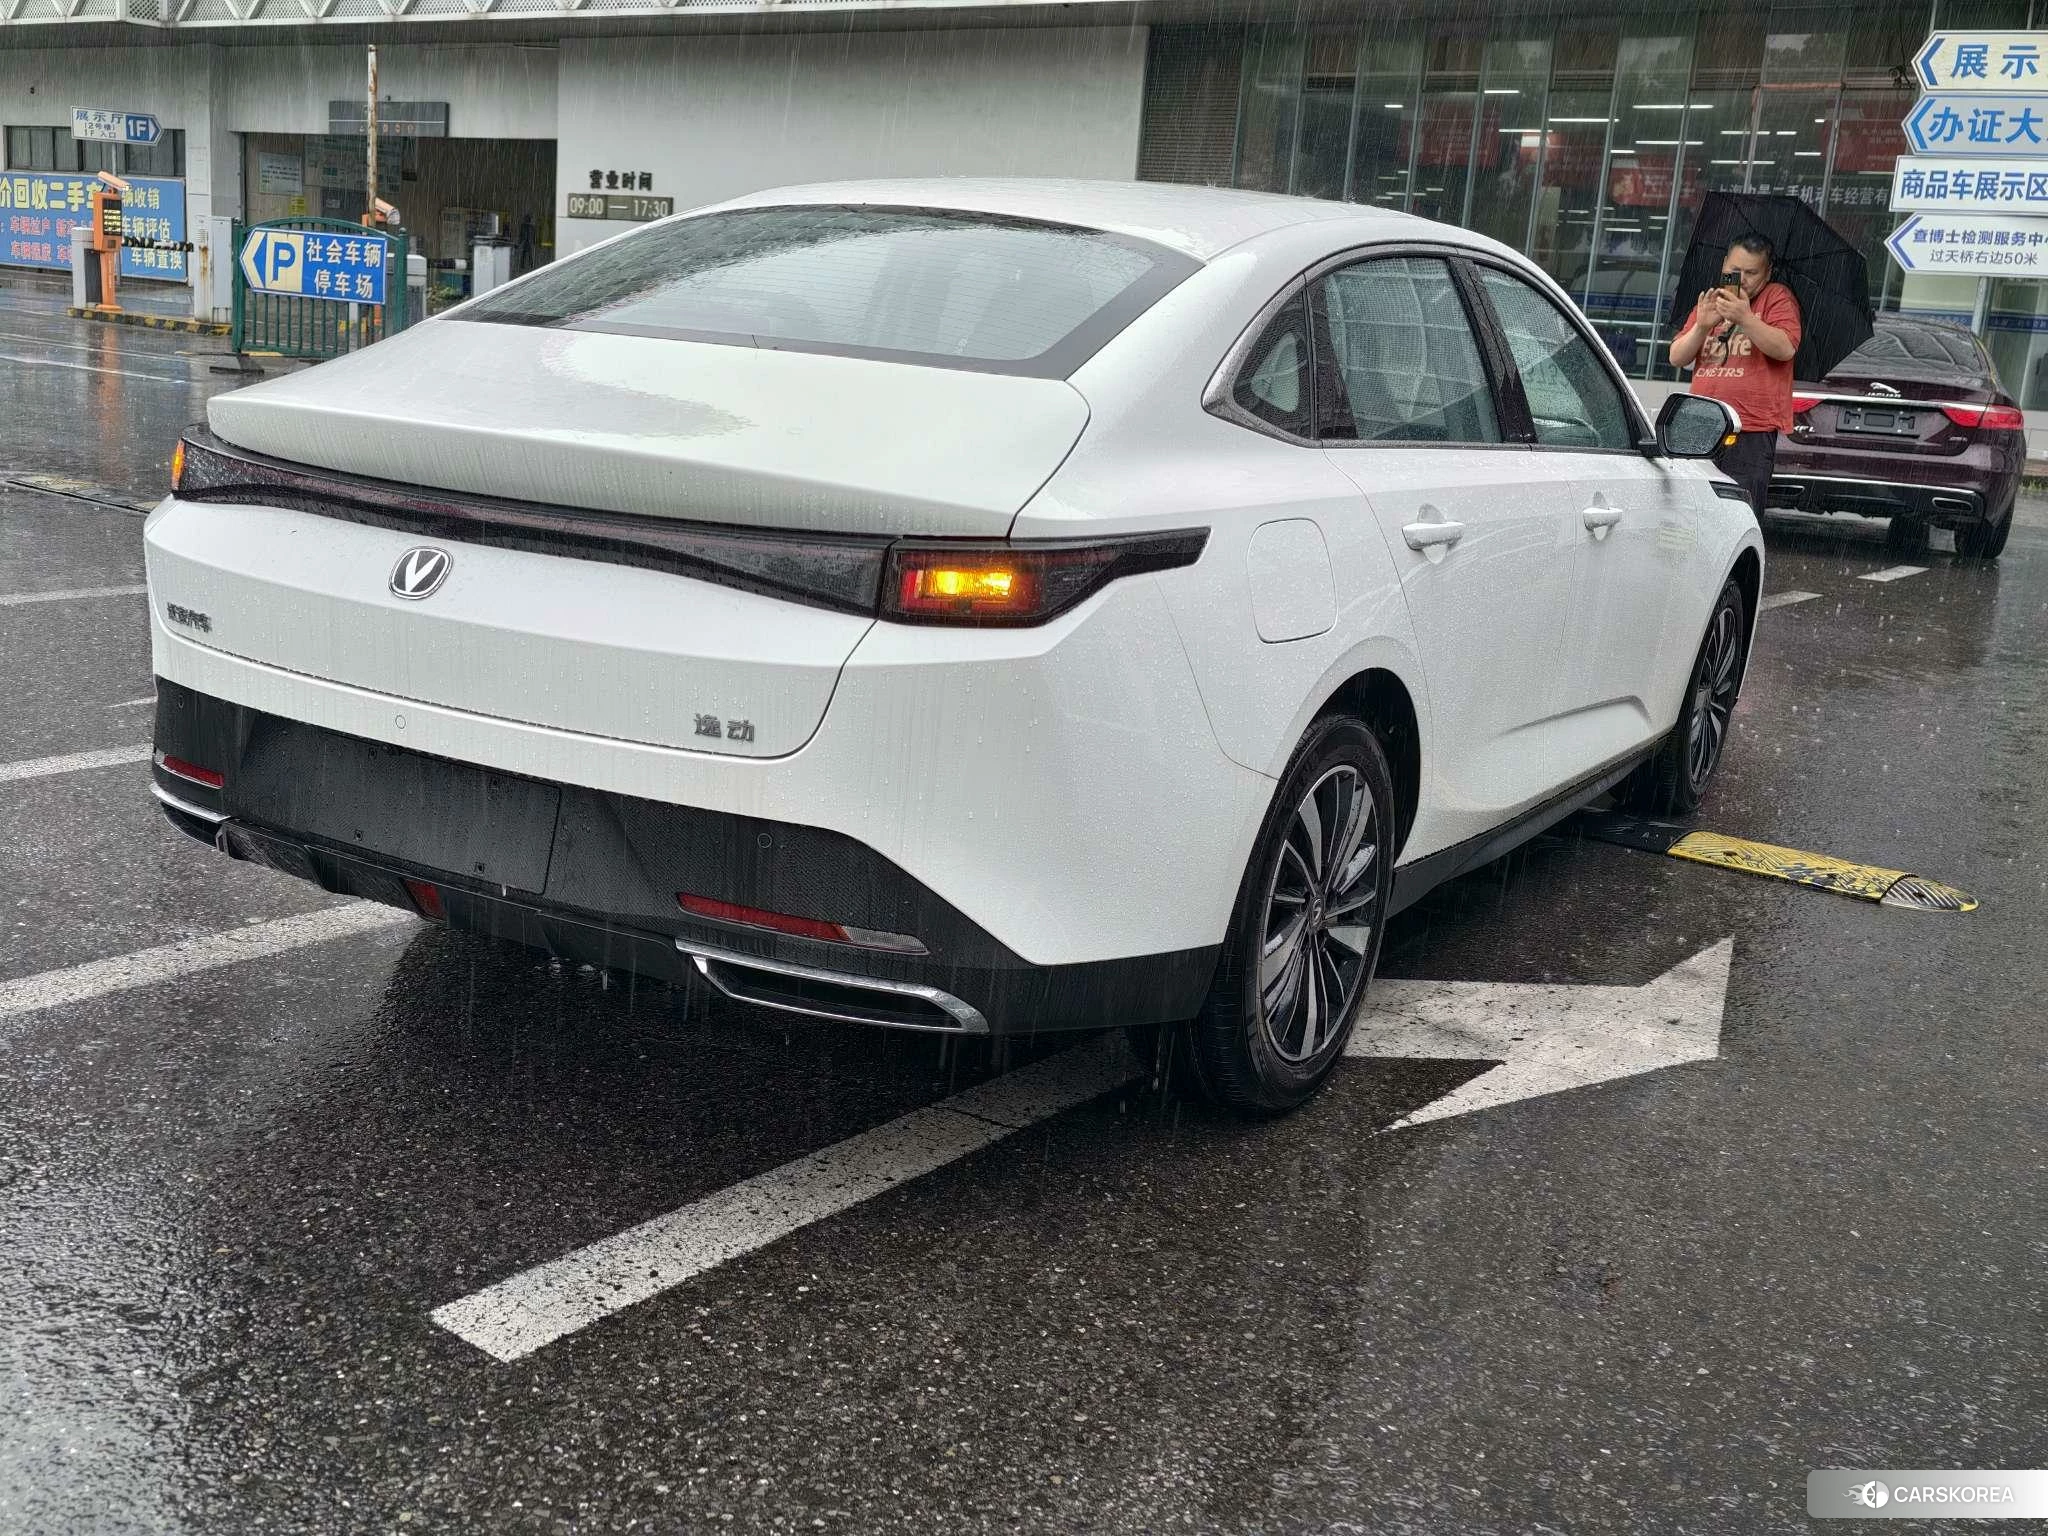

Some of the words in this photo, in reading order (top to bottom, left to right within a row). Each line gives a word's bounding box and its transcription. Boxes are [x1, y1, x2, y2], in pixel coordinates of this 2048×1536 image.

[1950, 44, 2041, 79] 展示
[76, 110, 124, 124] 展示厅
[126, 120, 147, 137] 1F
[1928, 106, 2048, 145] 办证大
[589, 169, 652, 191] 营业时间
[1900, 169, 2048, 201] 商品车展示区
[570, 197, 604, 215] 09:00
[633, 199, 668, 218] 17:30
[121, 216, 171, 240] 车辆评估
[131, 246, 183, 270] 车辆置换
[306, 237, 382, 268] 社会车辆
[1930, 249, 2040, 266] 过天桥右边50米
[314, 269, 374, 299] 停车场
[694, 713, 755, 742] 逸动
